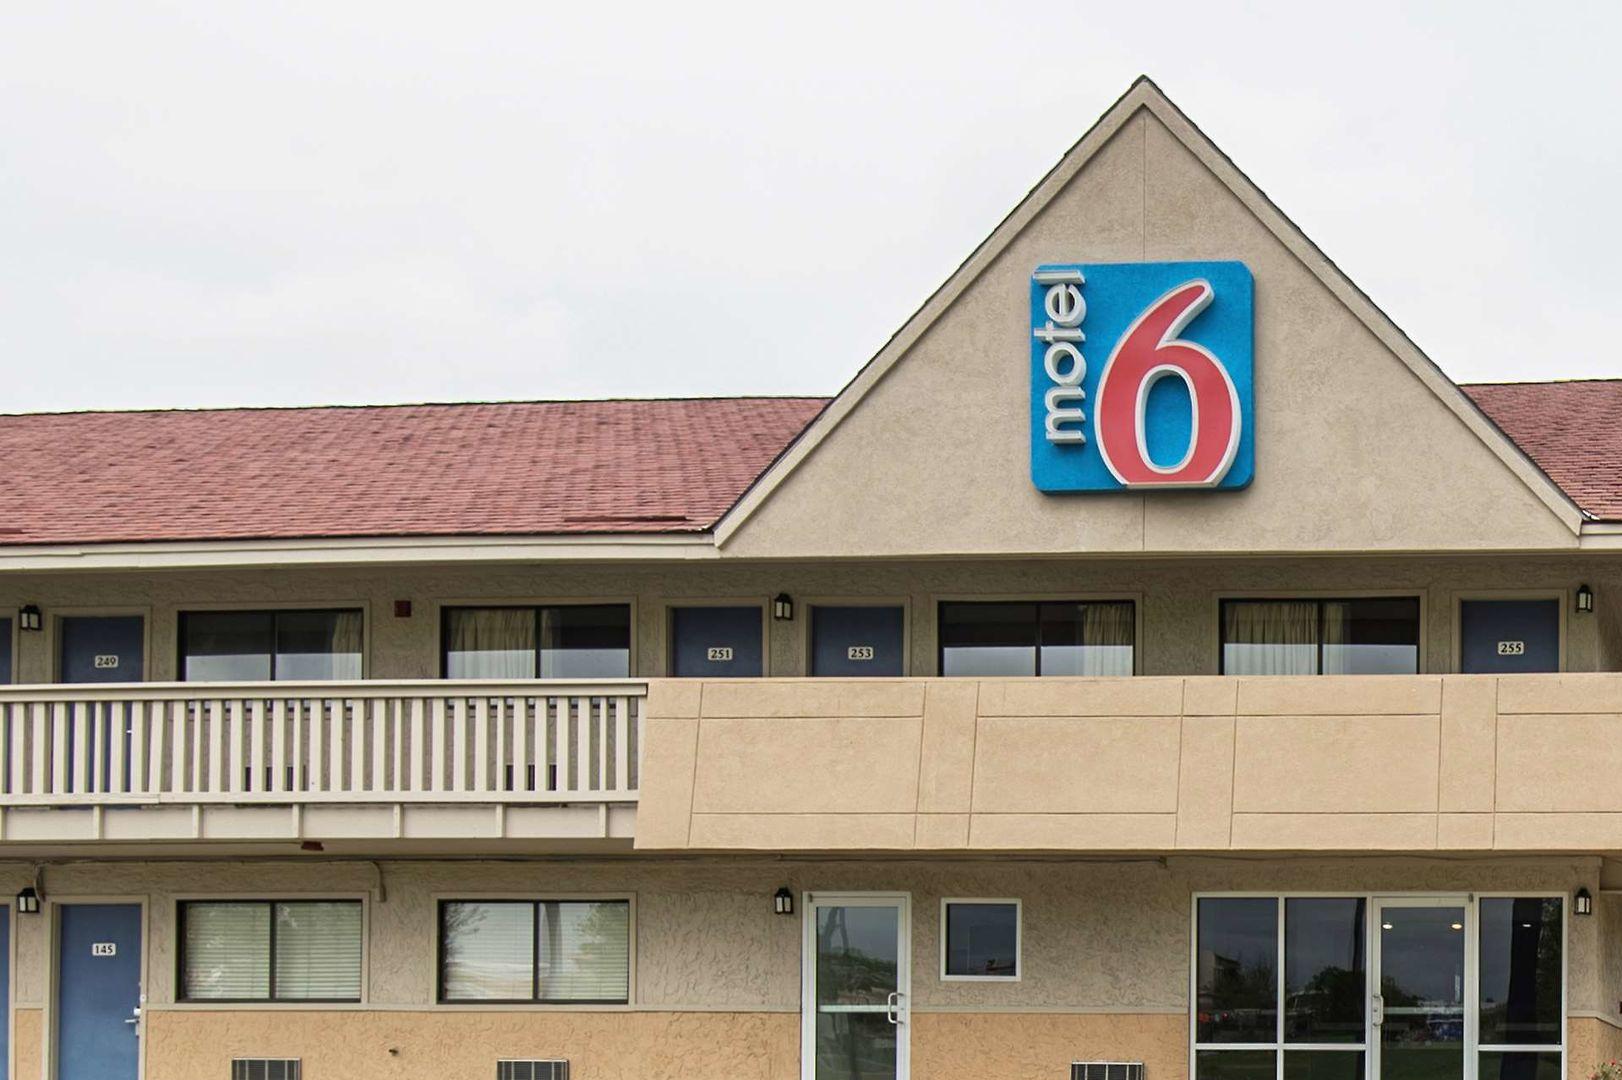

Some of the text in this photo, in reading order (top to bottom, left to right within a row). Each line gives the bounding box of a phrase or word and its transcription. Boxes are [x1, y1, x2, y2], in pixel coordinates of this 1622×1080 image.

[1033, 270, 1242, 489] motel 6
[851, 648, 871, 658] 253
[1500, 643, 1521, 653] 255
[710, 649, 730, 659] 251
[97, 656, 117, 667] 249
[95, 944, 113, 954] 145
